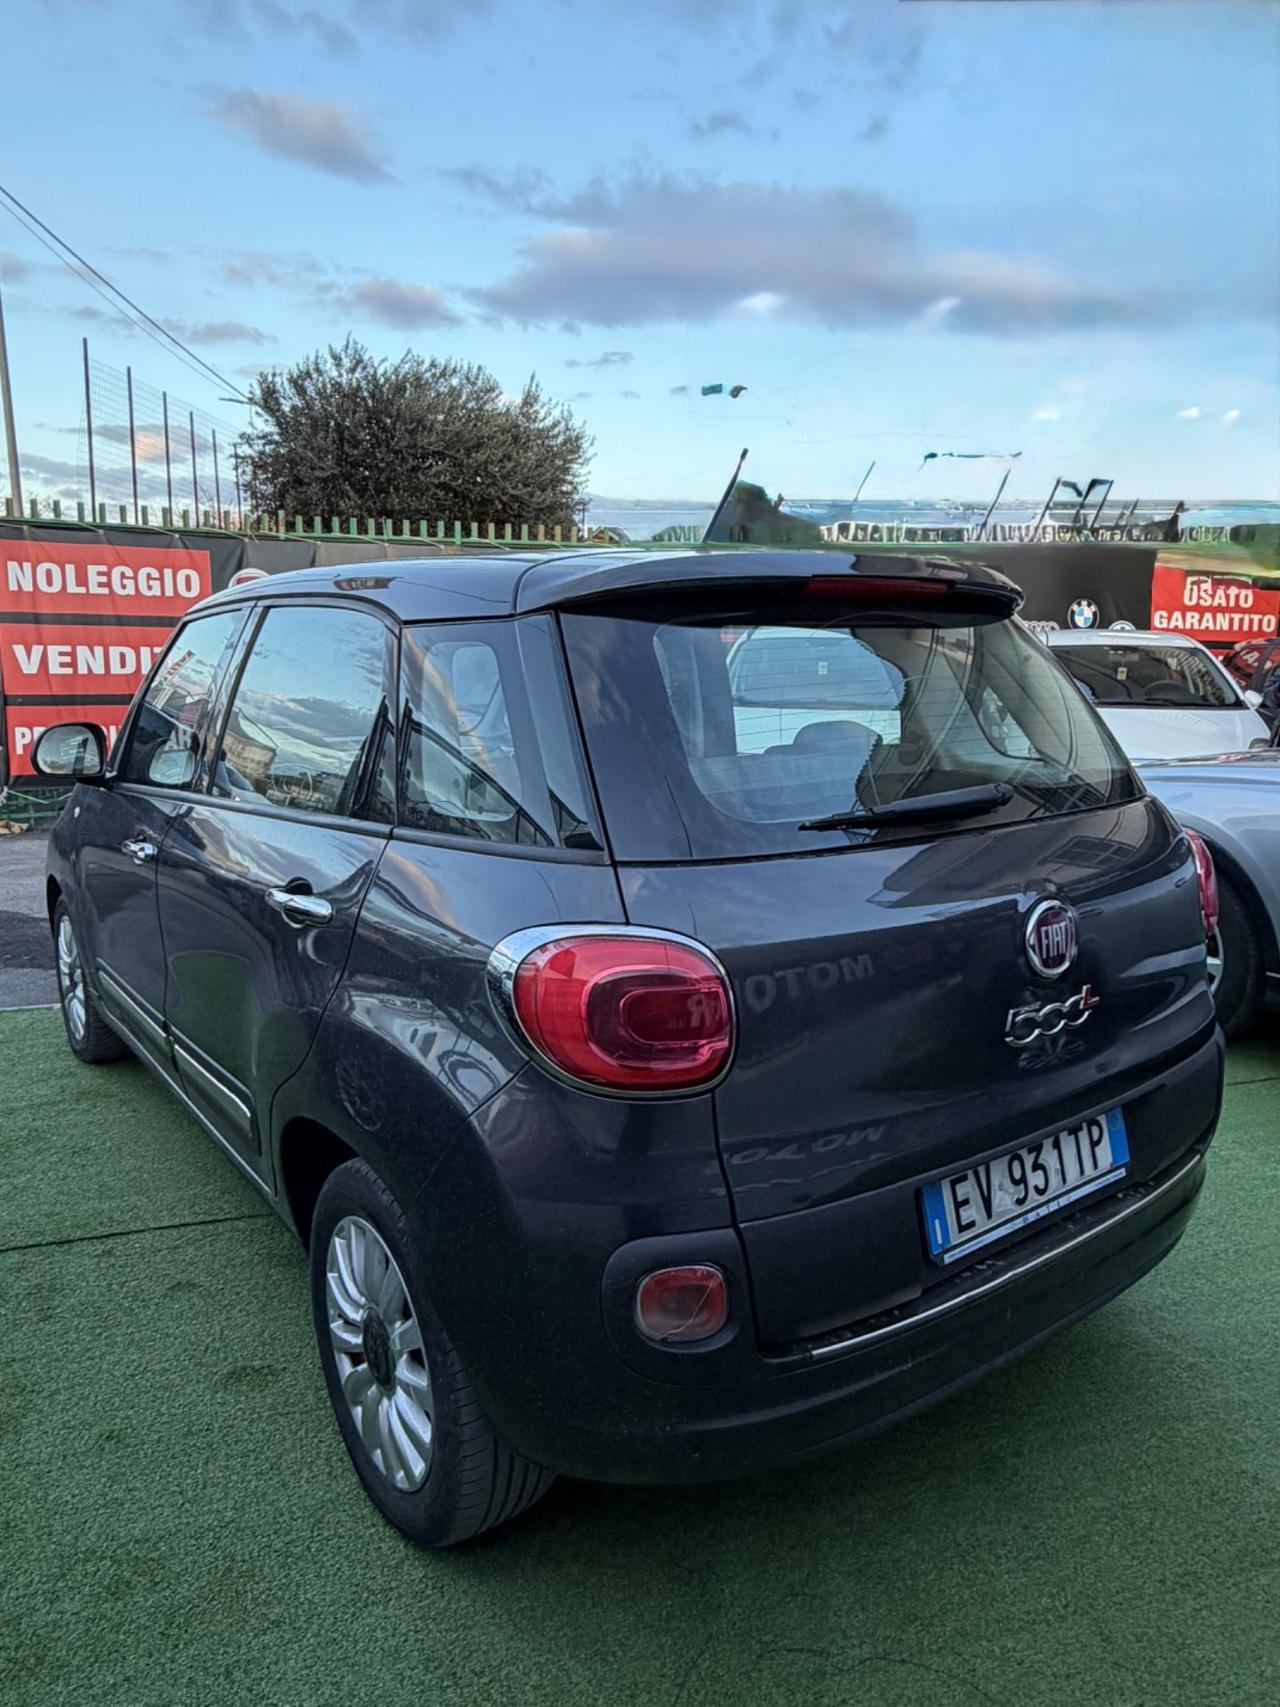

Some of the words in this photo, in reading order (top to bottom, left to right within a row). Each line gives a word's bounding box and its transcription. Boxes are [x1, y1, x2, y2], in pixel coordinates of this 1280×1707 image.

[6, 561, 201, 598] NOLEGGIO
[1183, 580, 1254, 608] USATO
[1155, 611, 1276, 632] GARANTITO
[1040, 922, 1067, 959] FIAT
